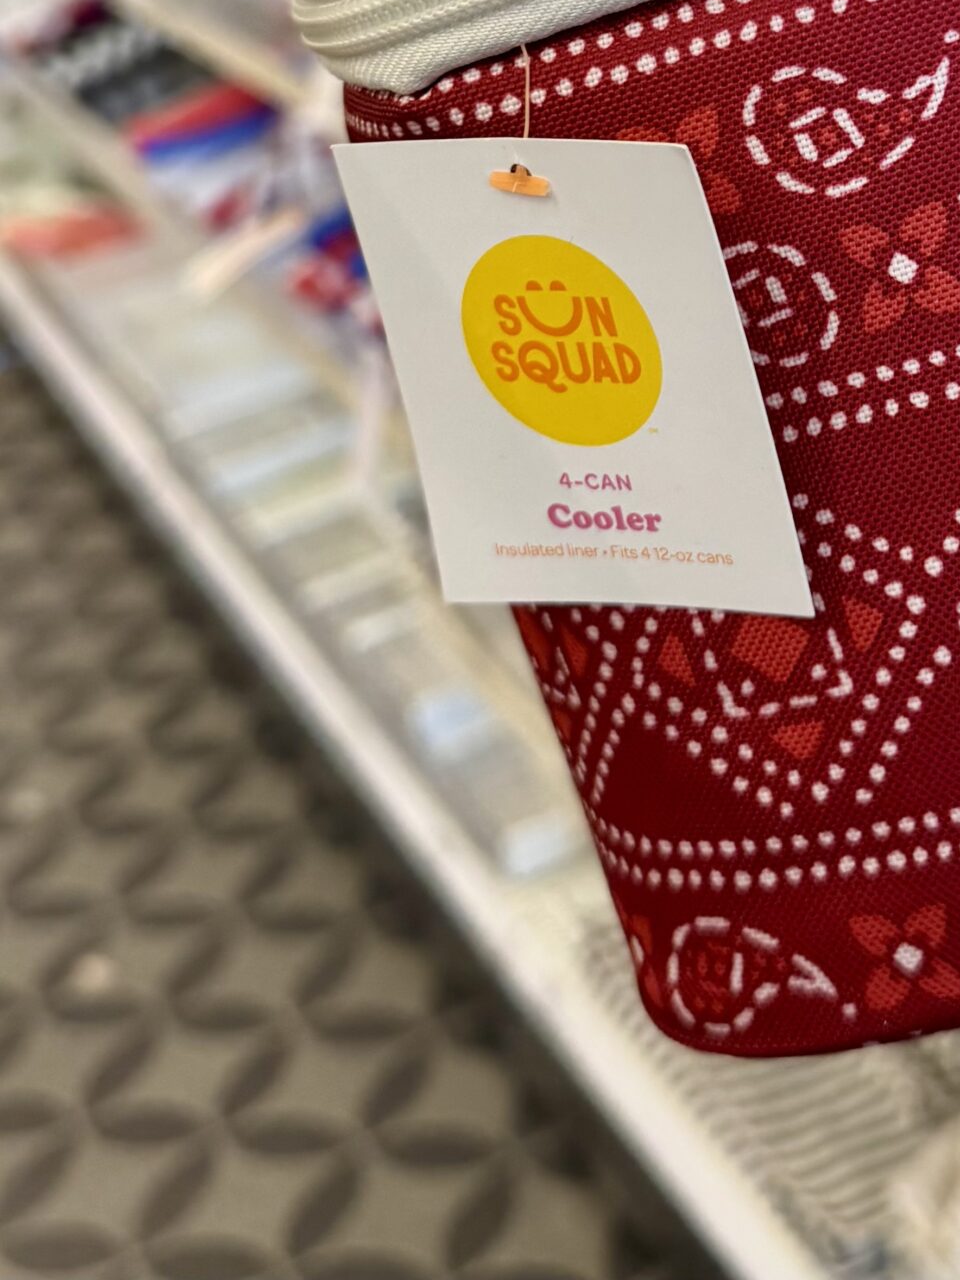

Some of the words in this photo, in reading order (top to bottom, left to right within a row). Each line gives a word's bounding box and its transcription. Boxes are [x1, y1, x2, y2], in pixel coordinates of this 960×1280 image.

[494, 292, 618, 337] SUN
[491, 341, 641, 392] SQUAD
[559, 472, 632, 491] 4-CAN
[547, 503, 662, 532] Cooler
[495, 542, 564, 557] Insulated
[567, 543, 598, 557] liner
[610, 545, 638, 559] Fits
[641, 546, 650, 559] 4
[655, 547, 693, 562] 12-oz
[697, 552, 734, 565] cans
